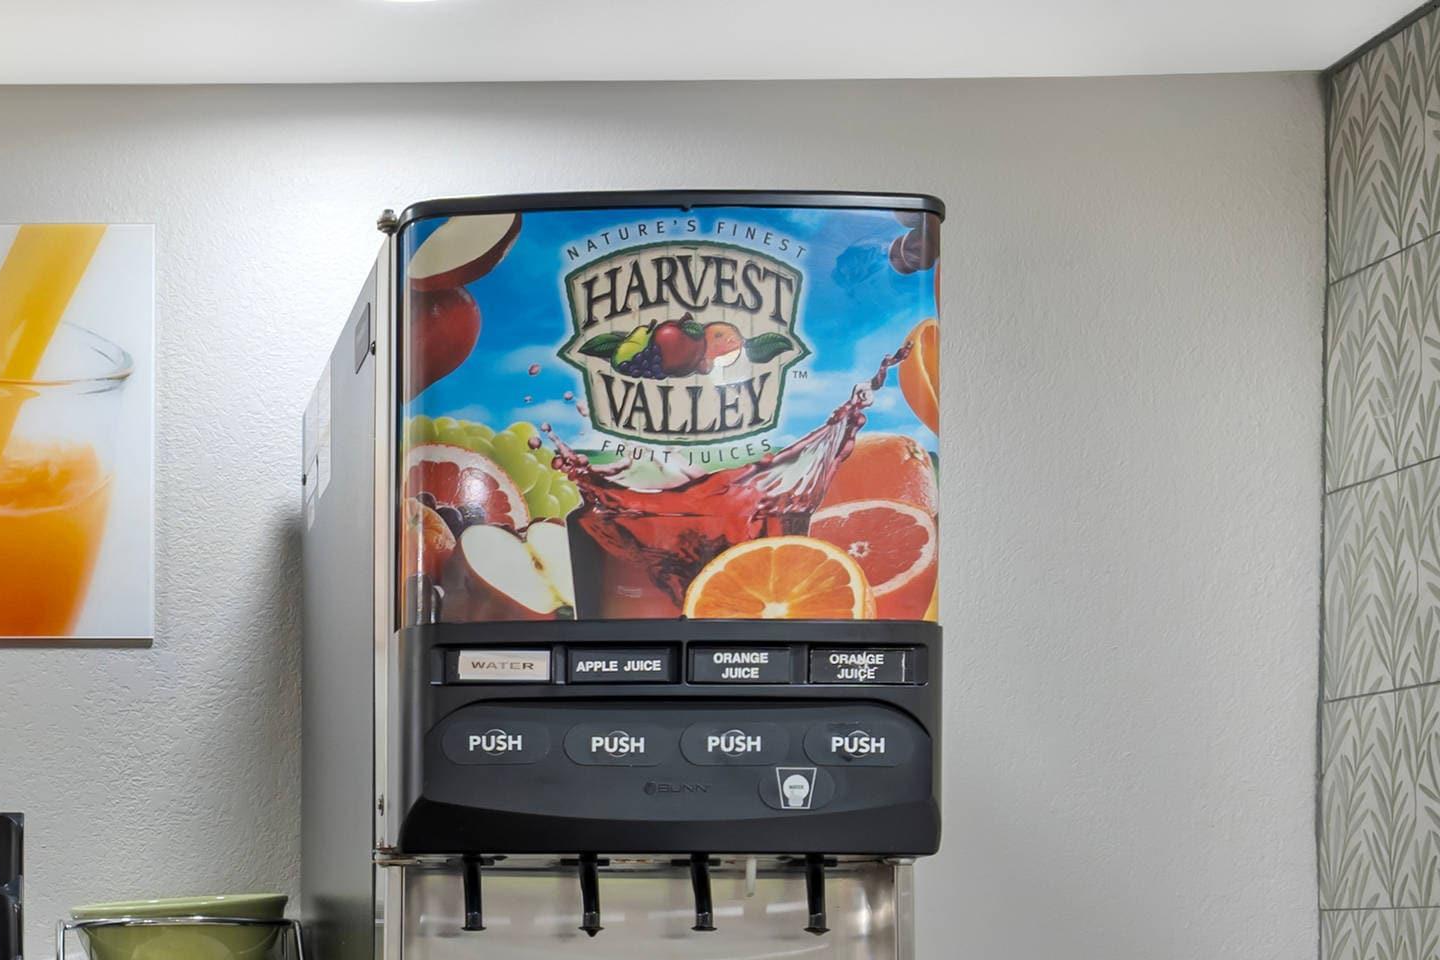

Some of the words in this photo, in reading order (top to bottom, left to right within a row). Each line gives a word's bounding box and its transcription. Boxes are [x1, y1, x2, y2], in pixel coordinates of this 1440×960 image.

[567, 219, 697, 260] NATURE'S
[716, 221, 807, 259] FINEST
[581, 255, 794, 330] HARVEST
[597, 371, 773, 435] VALLEY
[601, 440, 671, 463] FRUIT
[688, 439, 771, 466] JUICES
[471, 661, 534, 670] WATER
[576, 660, 618, 672] APPLE
[623, 659, 662, 672] JUICE
[713, 652, 769, 664] ORANGE
[829, 653, 884, 665] ORANGE
[721, 667, 760, 679] JUICE
[836, 668, 876, 680] JUICE
[469, 735, 523, 751] PUSH
[591, 736, 645, 753] PUSH
[707, 735, 762, 753] PUSH
[831, 736, 886, 753] PUSH
